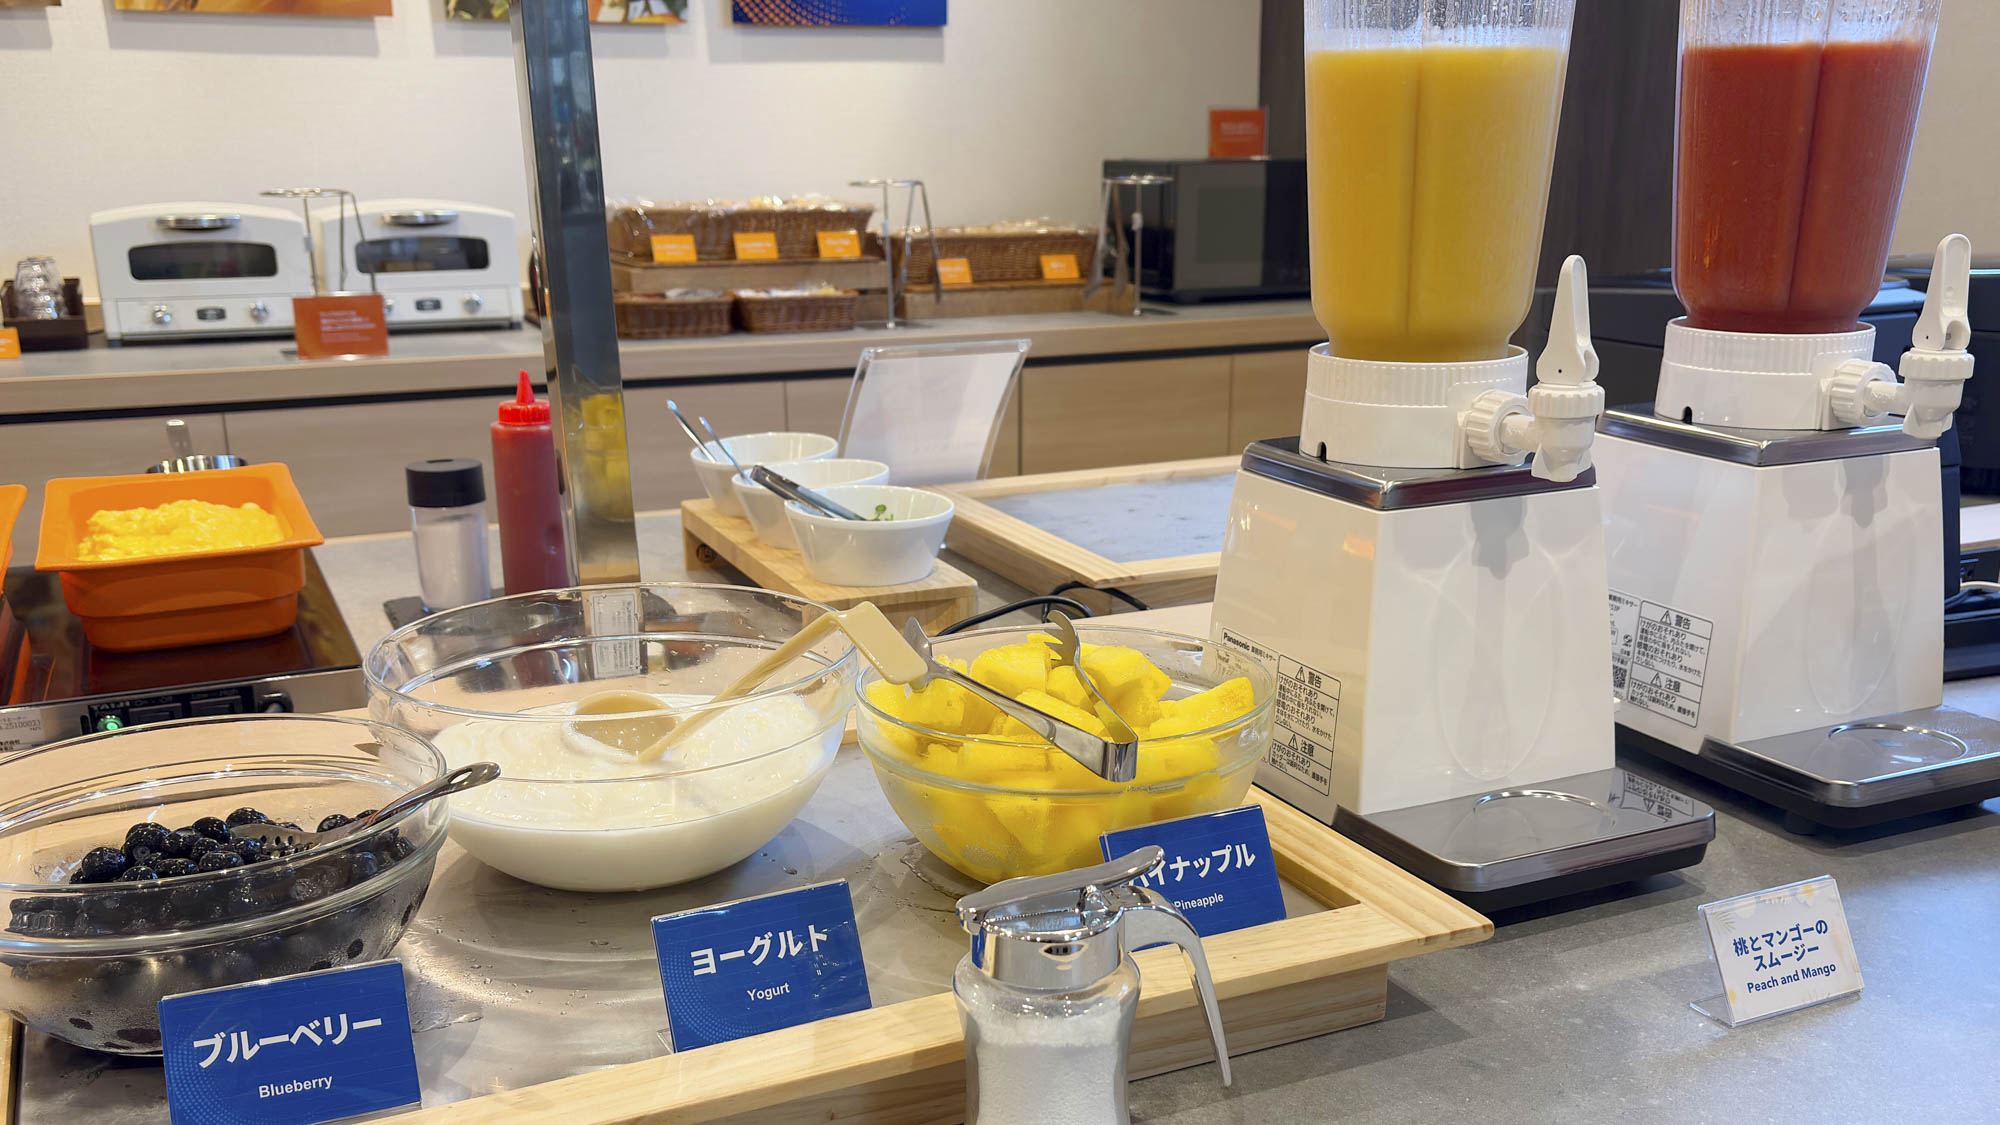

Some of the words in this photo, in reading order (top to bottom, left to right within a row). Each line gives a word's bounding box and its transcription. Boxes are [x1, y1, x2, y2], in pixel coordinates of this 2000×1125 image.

[1223, 632, 1250, 651] Panasonic
[1279, 674, 1318, 699] けがのおそれあり
[1307, 670, 1322, 689] 警告
[1664, 676, 1681, 693] 注意
[1272, 742, 1311, 768] けがのおそれあり
[1300, 739, 1314, 757] 注意
[1173, 892, 1224, 911] Pineapple
[690, 924, 828, 976] ヨーグルト
[1733, 919, 1828, 957] 桃とマンゴーの
[1753, 944, 1819, 972] スムージー
[1747, 976, 1779, 993] Peach
[1780, 970, 1800, 985] and
[1800, 963, 1836, 979] Mango
[747, 982, 790, 1001] Yogurt
[193, 1013, 382, 1069] ブルーベリー
[258, 1075, 333, 1099] Blueberry
